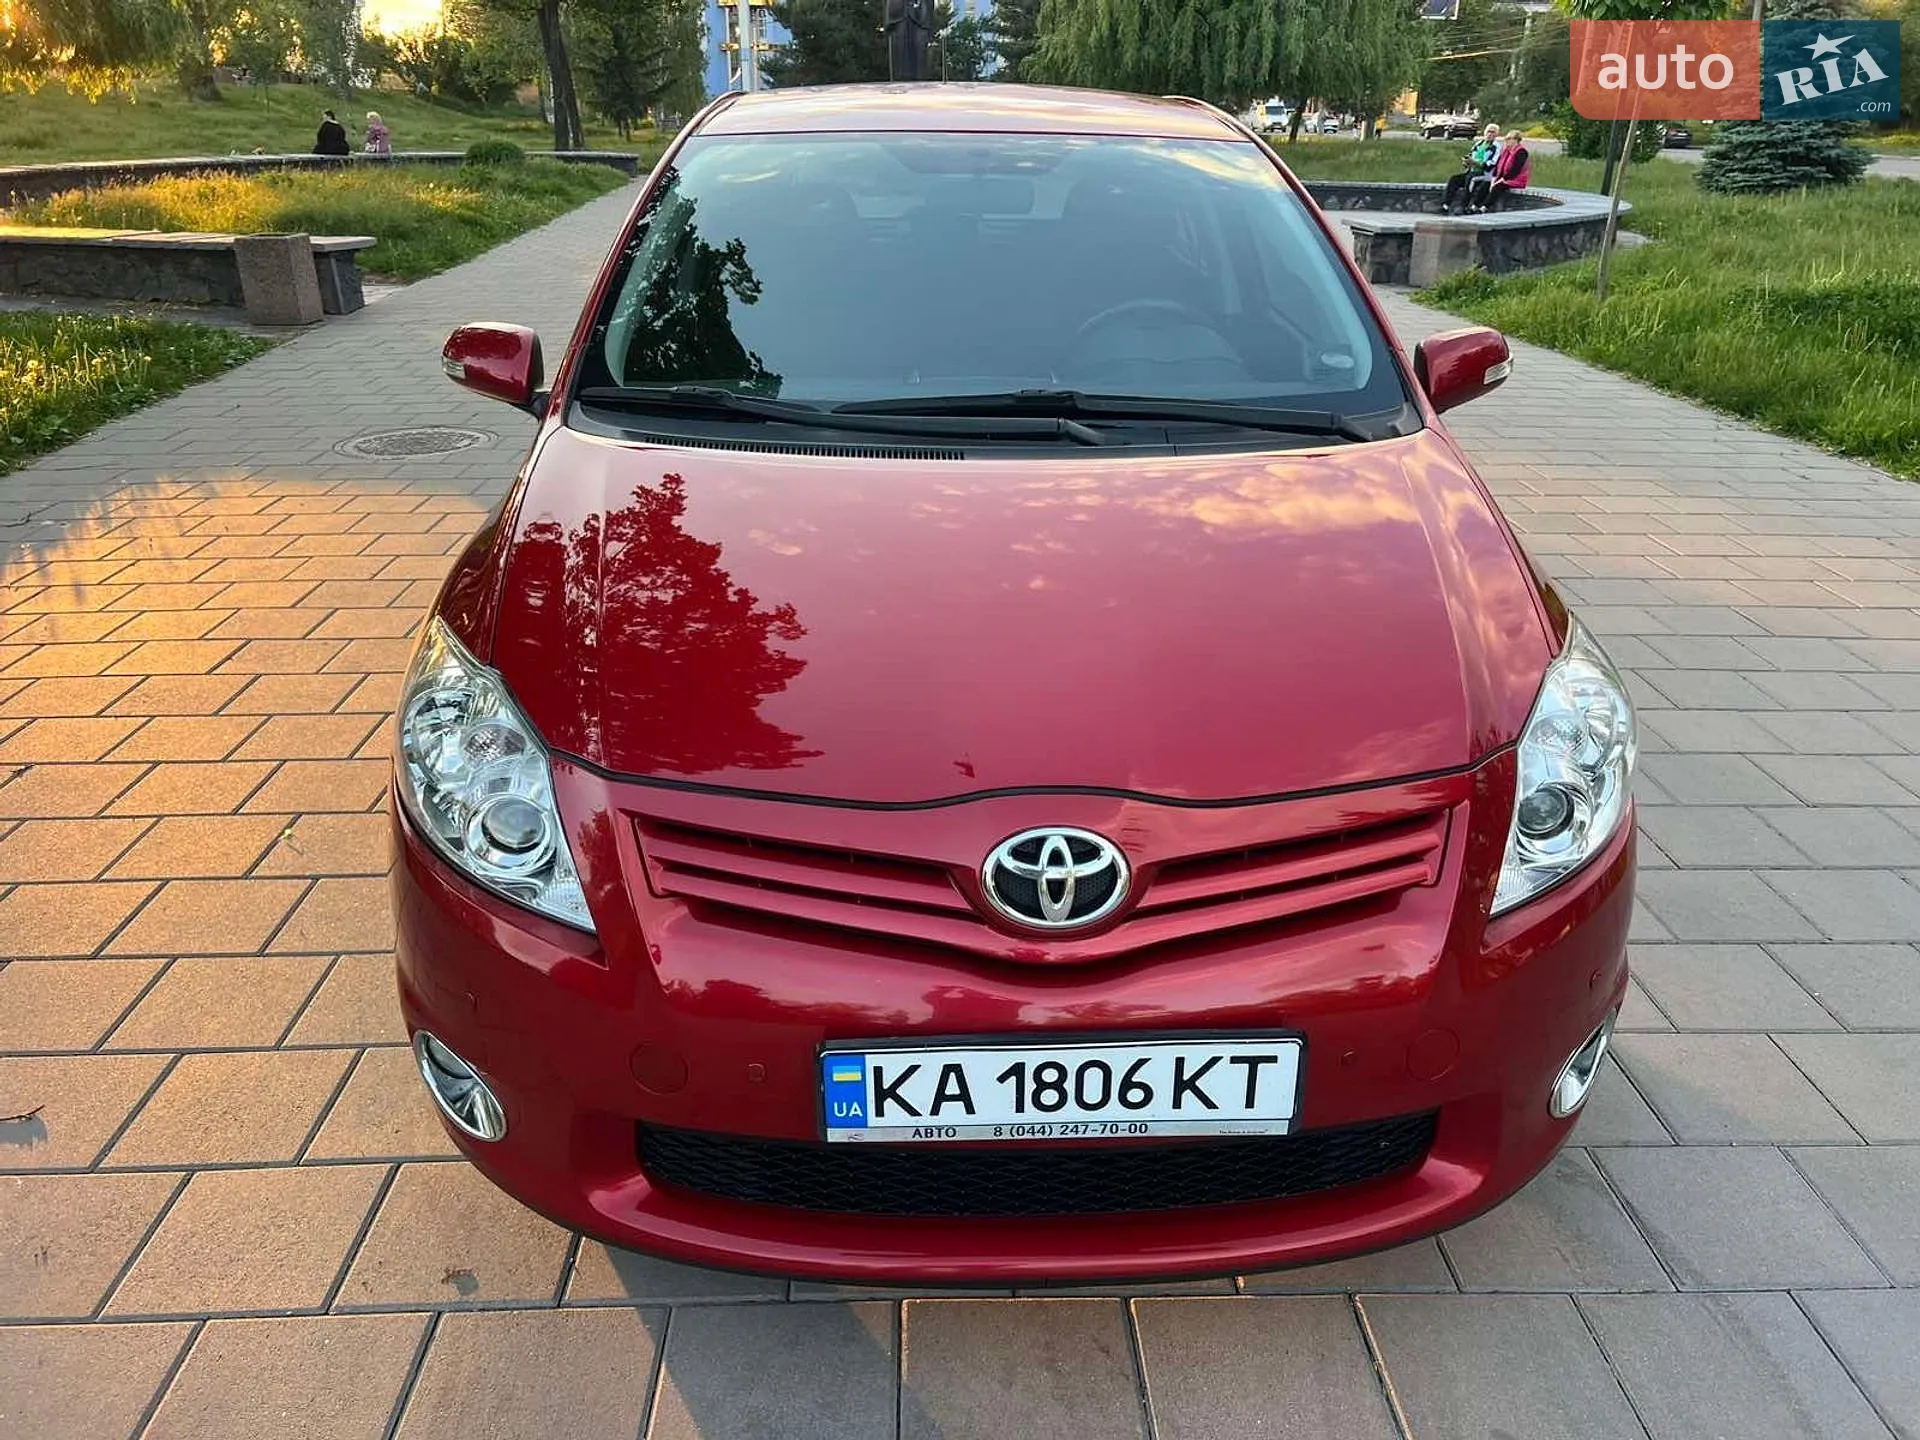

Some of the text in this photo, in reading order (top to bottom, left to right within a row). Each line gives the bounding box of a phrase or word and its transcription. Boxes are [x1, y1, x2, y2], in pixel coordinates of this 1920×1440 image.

[873, 1055, 1278, 1118] KA 1806 KT
[833, 1101, 863, 1117] UA
[993, 1126, 1004, 1138] 8
[1009, 1125, 1054, 1138] (044)
[1059, 1123, 1149, 1136] 247-70-00
